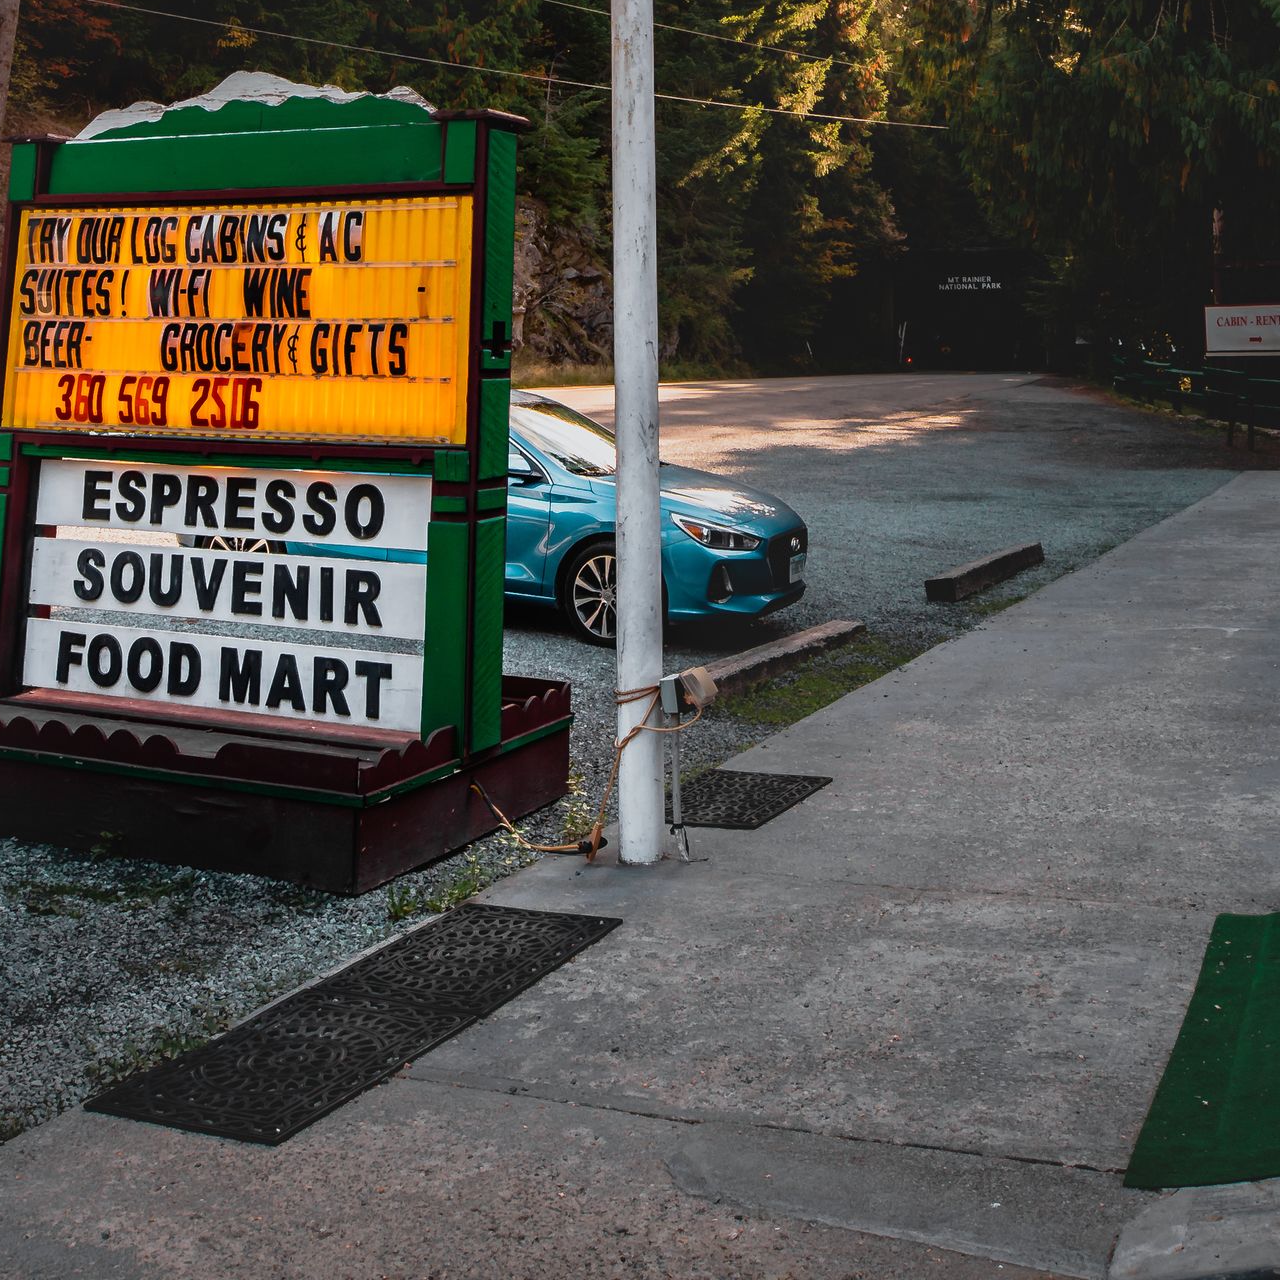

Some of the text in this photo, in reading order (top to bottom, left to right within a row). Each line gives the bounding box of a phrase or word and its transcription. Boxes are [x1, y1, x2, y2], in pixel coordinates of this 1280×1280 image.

[27, 218, 72, 264] TRY
[76, 217, 125, 264] OUR
[130, 217, 179, 264] LOG
[185, 213, 287, 263] CABINS
[150, 269, 213, 317] WI-FI
[243, 269, 312, 319] WINE
[962, 275, 992, 283] RAINIER
[1216, 316, 1248, 327] CABIN
[160, 322, 287, 373] GROCERY
[310, 323, 408, 376] GIFTS
[55, 373, 263, 429] 360 569 2506
[82, 470, 385, 539] ESPRESSO
[73, 548, 383, 627] SOUVENIR
[56, 631, 392, 719] FOOD MART
